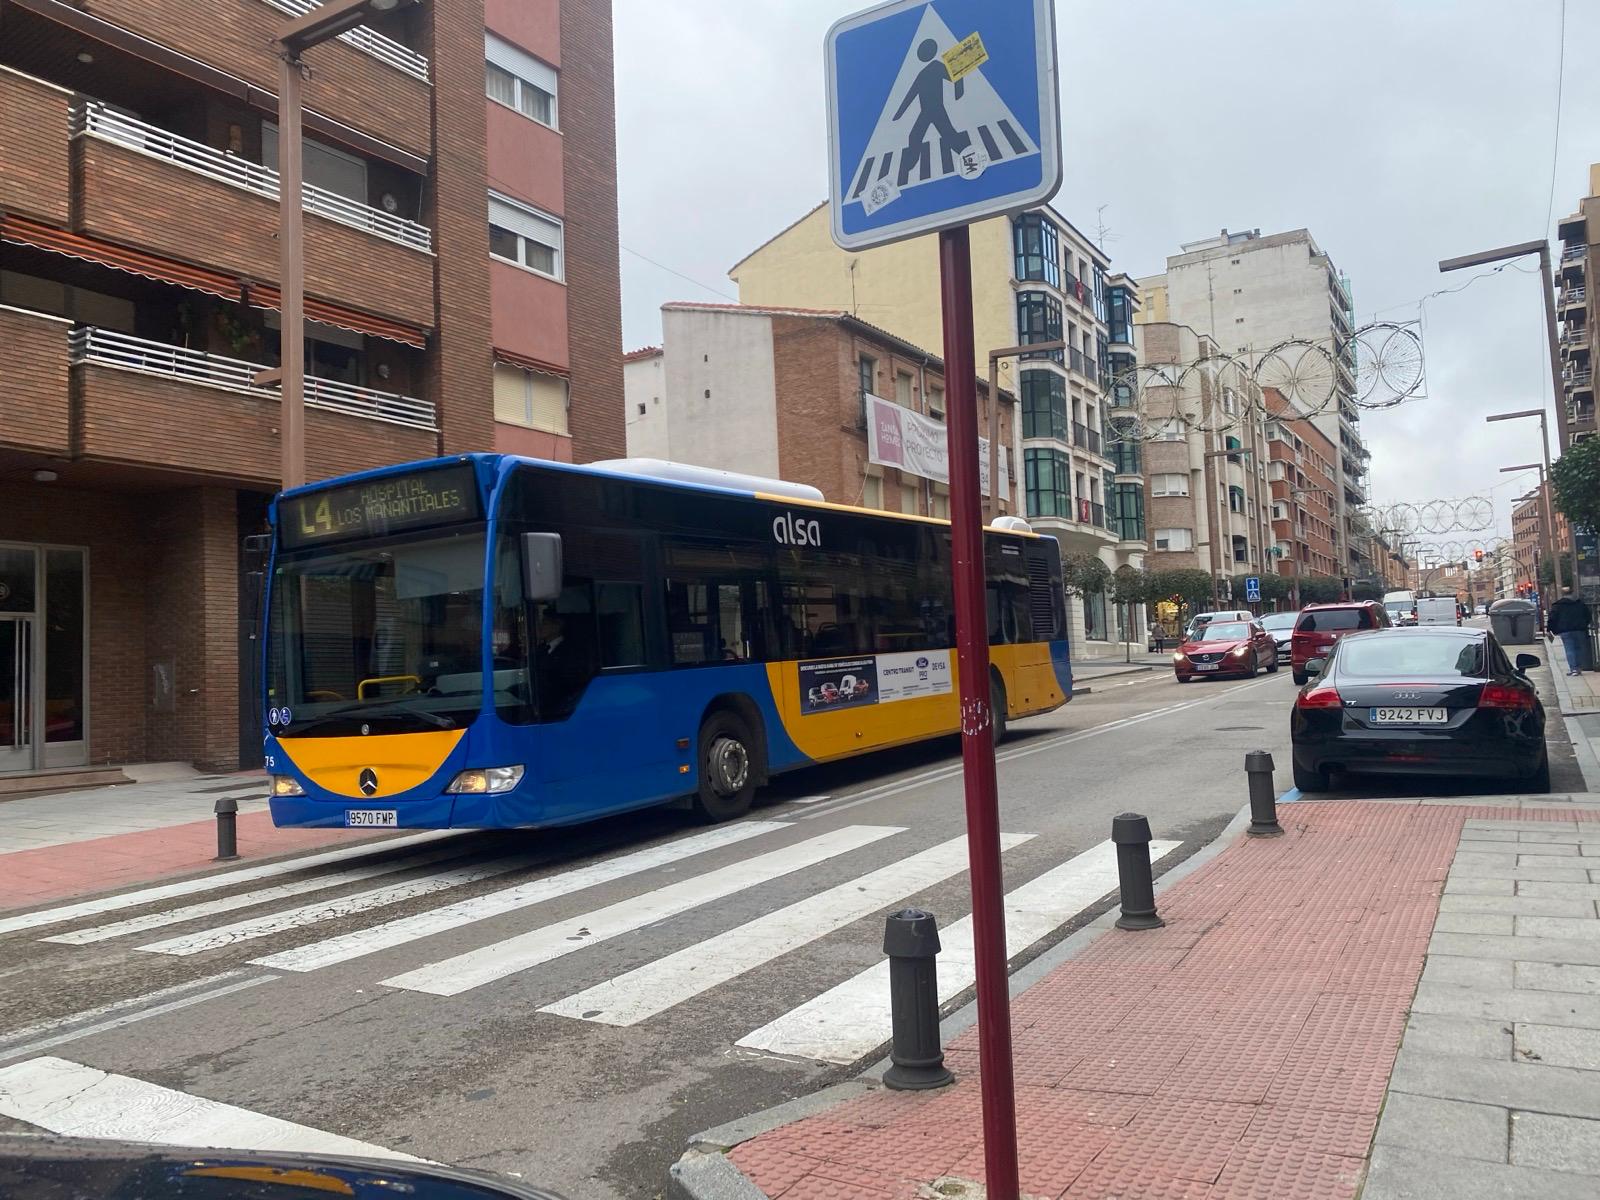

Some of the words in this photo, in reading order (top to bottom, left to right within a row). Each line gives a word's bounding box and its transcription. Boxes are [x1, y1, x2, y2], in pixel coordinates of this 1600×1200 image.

[337, 507, 362, 526] LOS
[365, 489, 461, 522] MANANTIALES
[360, 479, 429, 505] HOSPITAL
[299, 496, 332, 535] L4
[773, 511, 821, 547] alsa
[1379, 709, 1413, 721] 9242
[1418, 709, 1445, 721] FVJ
[350, 812, 374, 825] 9570
